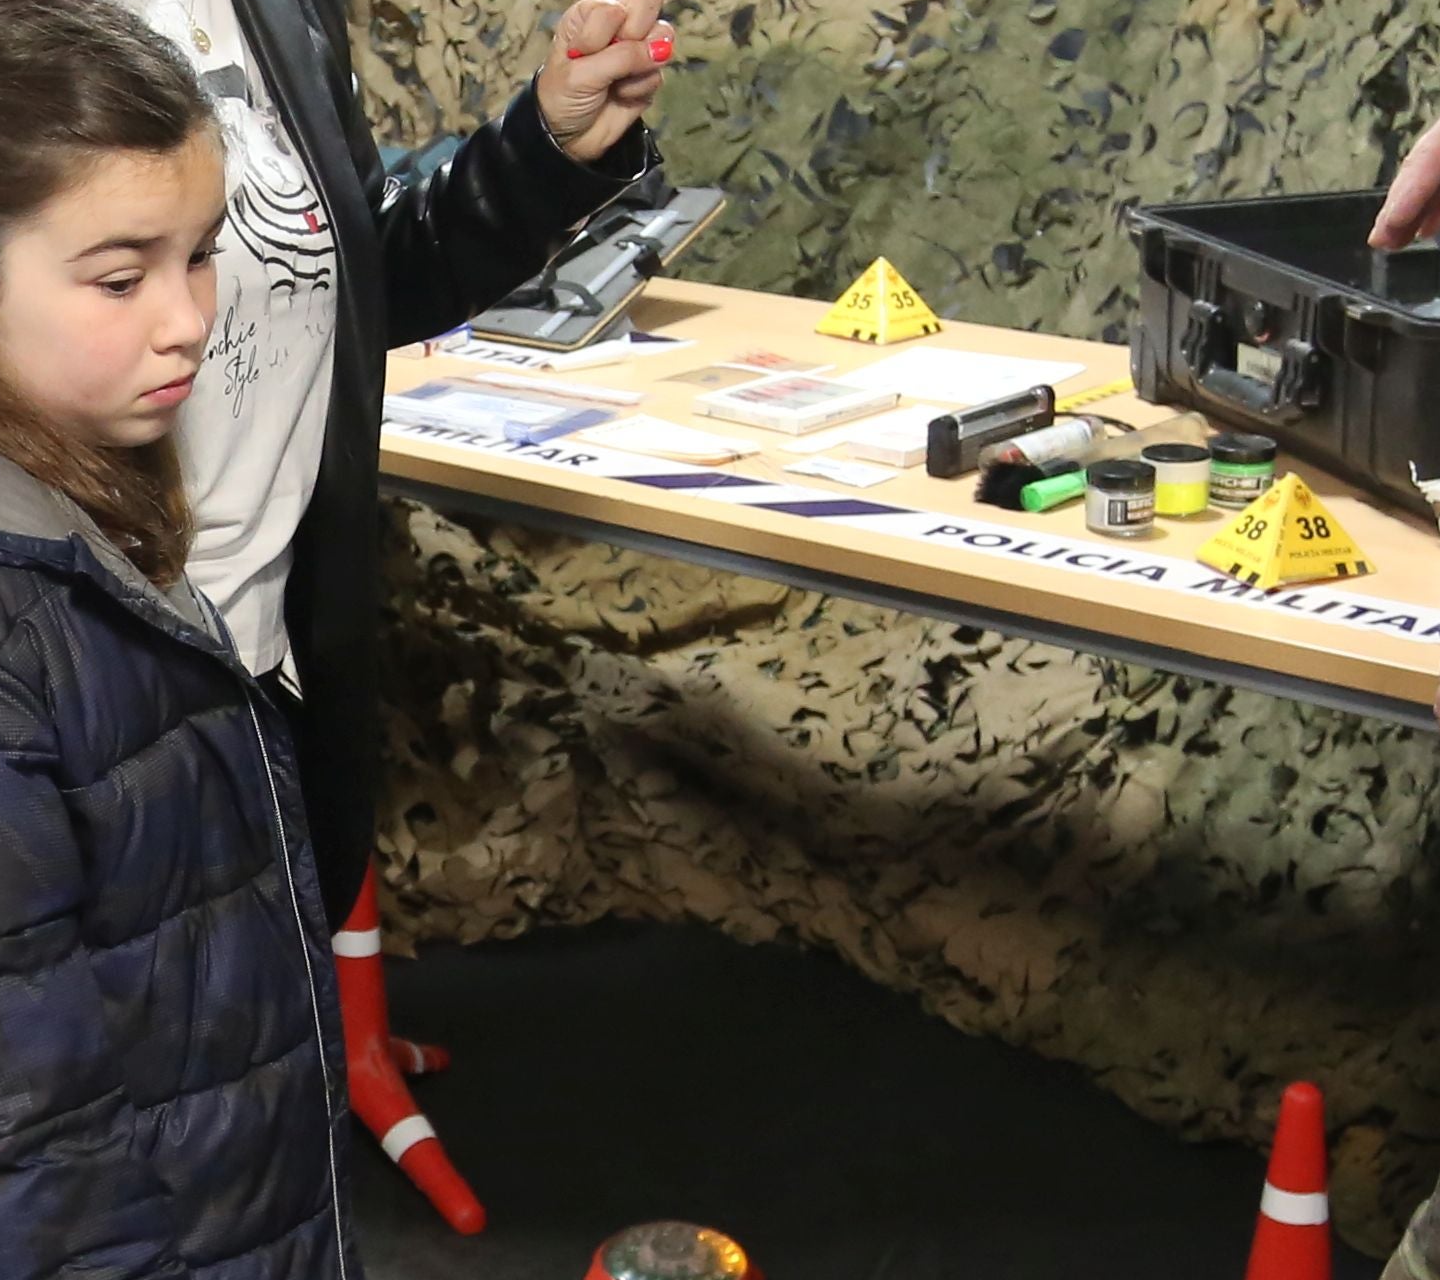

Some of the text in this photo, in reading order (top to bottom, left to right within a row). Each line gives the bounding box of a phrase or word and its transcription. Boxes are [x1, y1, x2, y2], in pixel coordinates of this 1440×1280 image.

[846, 292, 873, 310] 35
[890, 290, 915, 310] 35
[202, 306, 256, 362] nchie
[1235, 514, 1268, 541] 38
[1295, 516, 1331, 540] 38
[923, 524, 1169, 581] POLICIA
